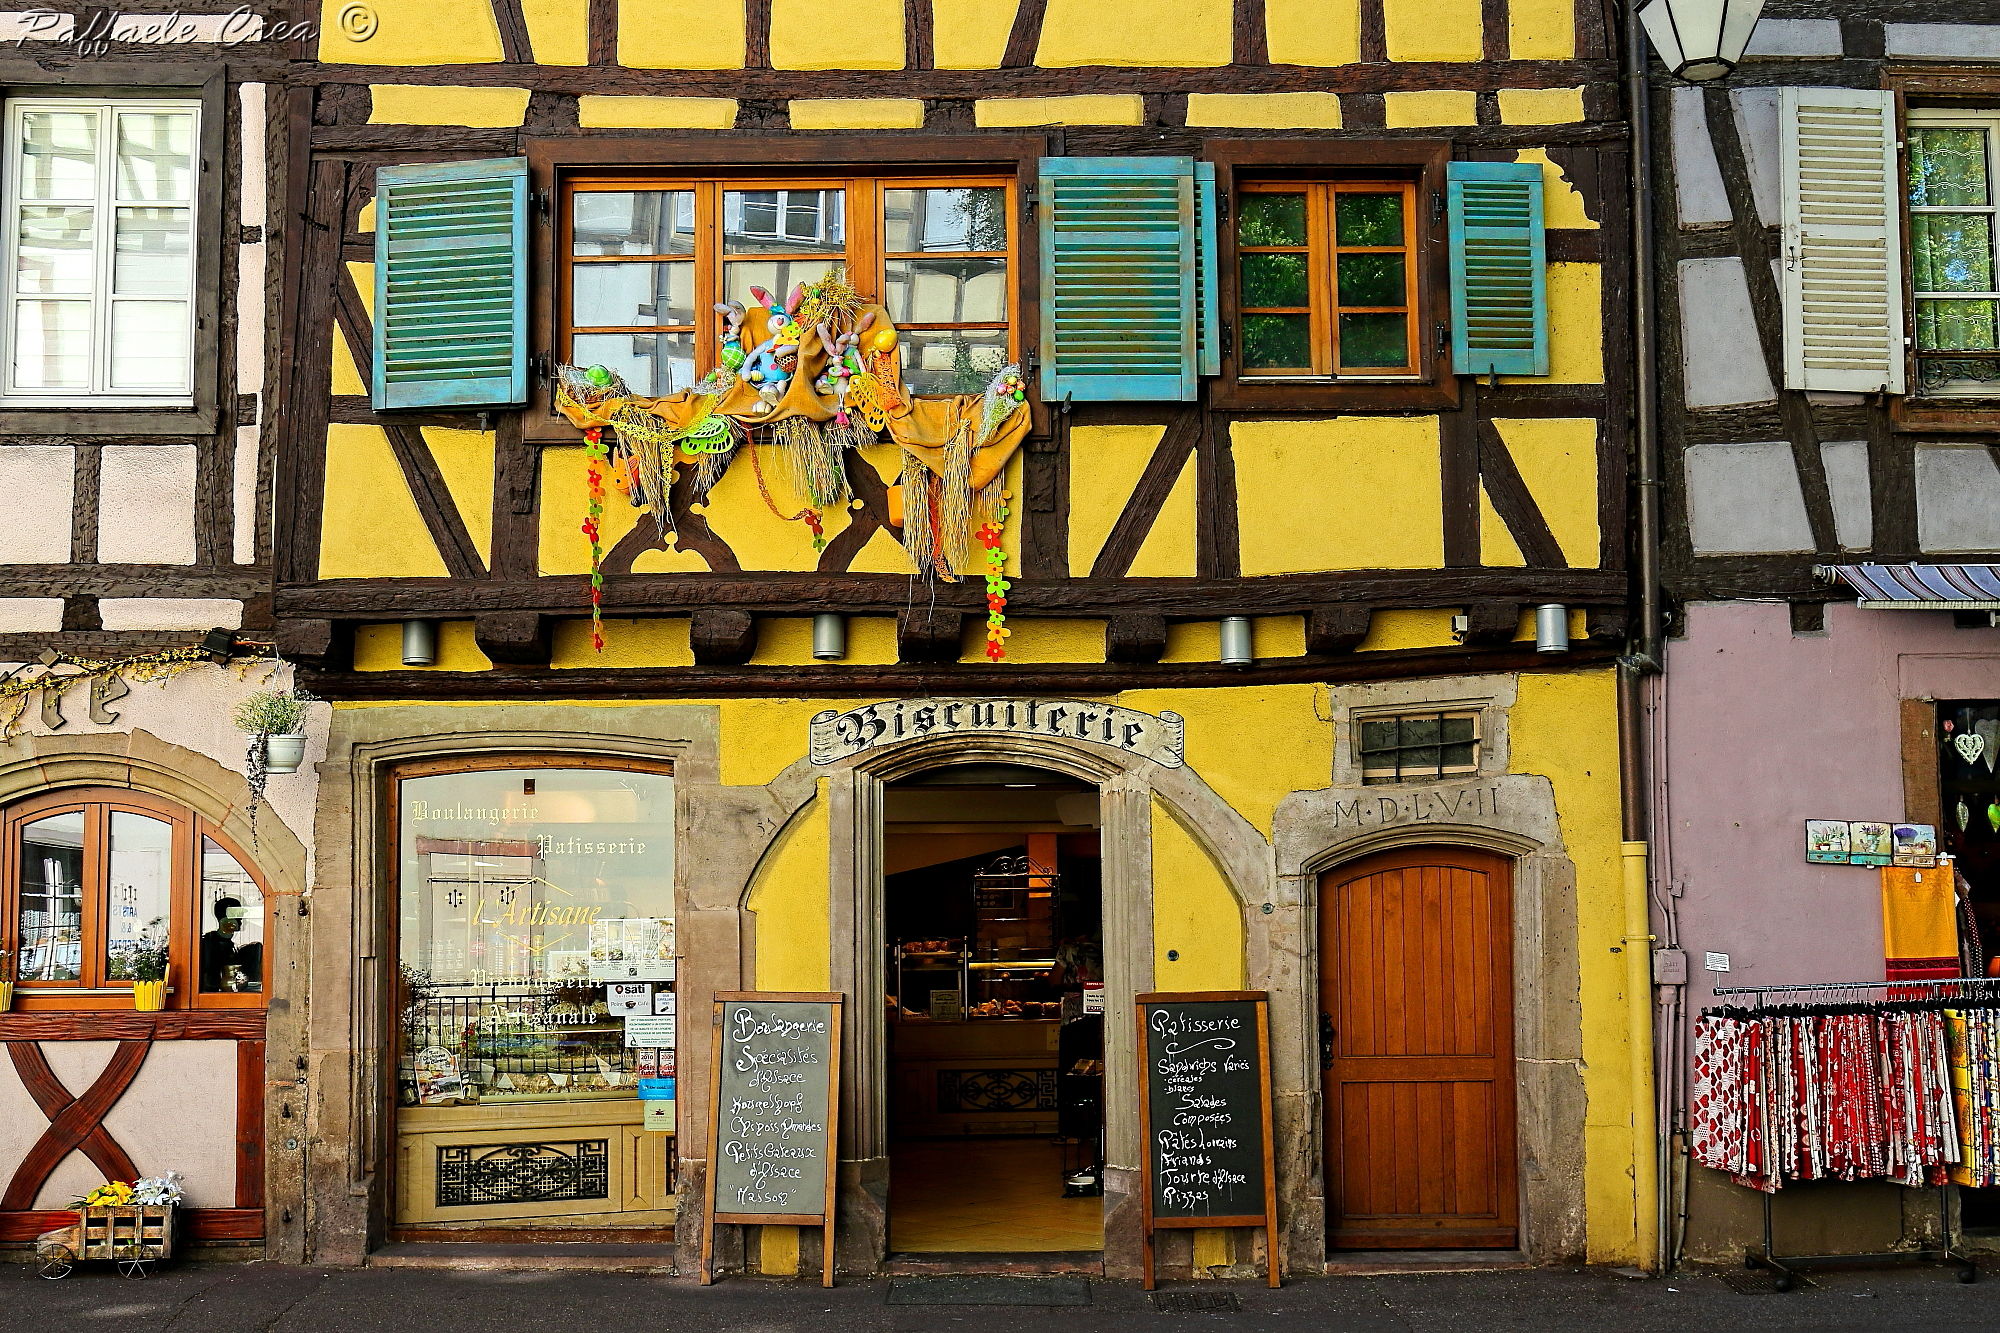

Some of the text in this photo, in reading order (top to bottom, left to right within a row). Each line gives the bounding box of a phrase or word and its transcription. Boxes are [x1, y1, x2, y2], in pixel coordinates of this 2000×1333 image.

[836, 699, 1144, 750] Biscuiterie
[411, 801, 539, 827] Boulangerie
[537, 835, 647, 860] Patisserie
[733, 1008, 825, 1042] Boulangerie
[1152, 1010, 1240, 1039] Patisserie
[1175, 1094, 1227, 1110] Salades
[725, 1141, 763, 1163] Petits
[1161, 1151, 1212, 1168] Friands
[749, 1161, 801, 1190] d'Alsace
[1160, 1168, 1210, 1186] Tourte
